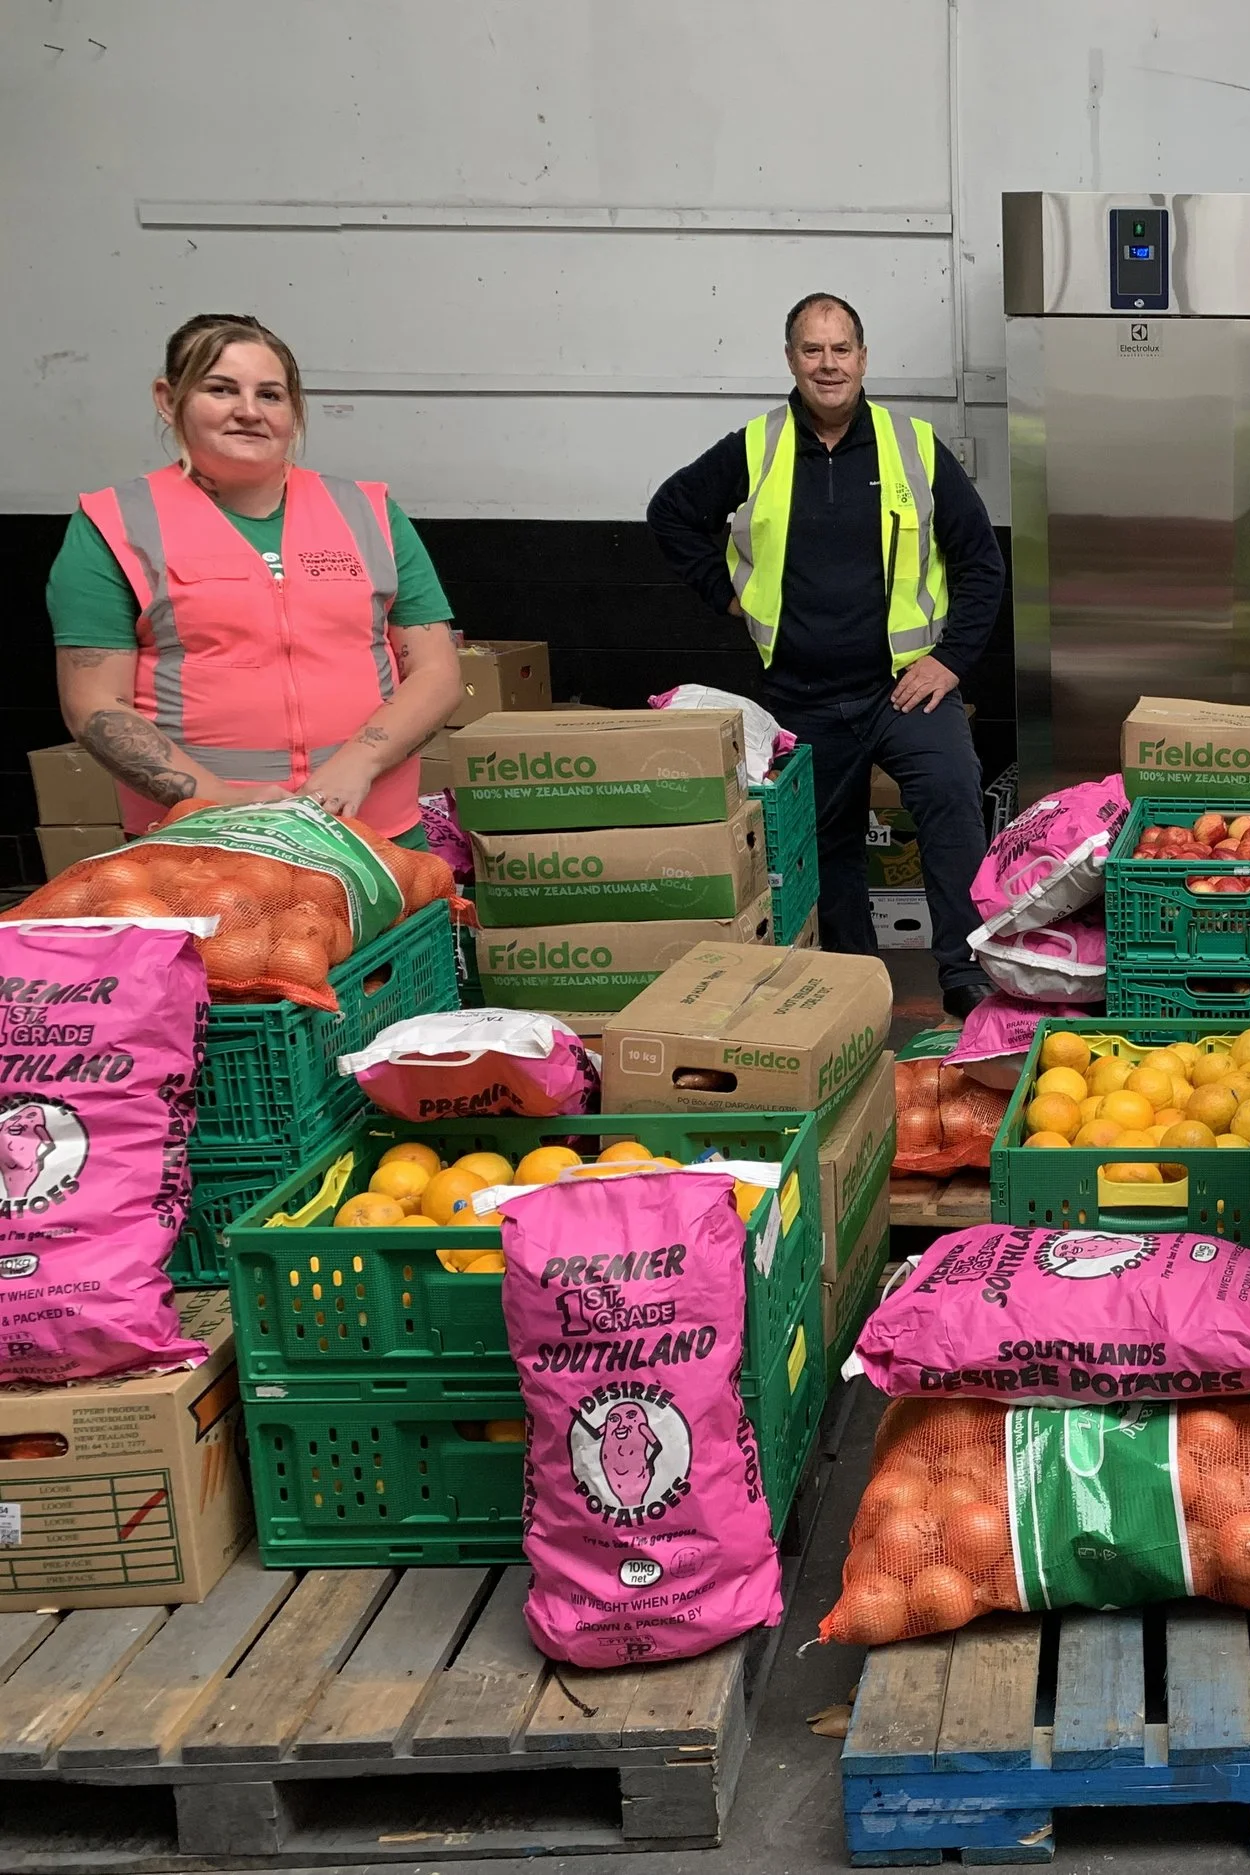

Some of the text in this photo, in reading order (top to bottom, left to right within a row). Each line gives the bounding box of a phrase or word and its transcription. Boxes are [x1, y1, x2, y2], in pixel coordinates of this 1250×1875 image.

[1120, 344, 1160, 353] Electrolux
[467, 751, 597, 782] Fieldco
[1139, 771, 1165, 782] 100%
[1167, 772, 1192, 783] NEW
[1195, 773, 1248, 785] ZEALAND
[471, 783, 651, 800] 100% NEW ZEALAND KUMARA
[228, 841, 273, 854] Packers
[485, 851, 604, 881] Fieldco
[514, 881, 658, 897] NEW ZEALAND KUMARA
[488, 939, 613, 970] Fieldco
[493, 973, 656, 987] 100% NEW ZEALAND KUMAR
[0, 975, 119, 1005] REMIER
[13, 1024, 95, 1046] GRADE
[627, 1050, 657, 1065] 10 kg
[723, 1046, 800, 1070] Fieldco
[817, 1026, 874, 1100] Fieldco
[677, 1096, 690, 1105] PO
[691, 1097, 706, 1106] Box
[708, 1099, 723, 1108] 457
[539, 1243, 688, 1290] PREMIER
[8, 1281, 101, 1301] WHEN PACKED
[2, 1304, 84, 1327] & PACKED BY
[592, 1300, 676, 1335] GRADE
[532, 1324, 718, 1374] SOUTHLAND
[997, 1340, 1167, 1367] SOUTHLAND'S
[1070, 1370, 1243, 1398] POTATOES
[97, 1431, 140, 1441] ZEALAND
[40, 1485, 72, 1494] LOOSE
[41, 1502, 73, 1511] LOOSE
[574, 1476, 692, 1528] POTATOES
[44, 1518, 76, 1527] LOOSE
[46, 1533, 79, 1542] LOOSE
[650, 1528, 697, 1547] gorgeous
[42, 1559, 92, 1569] PRE-PACK
[627, 1561, 655, 1577] 10kg
[630, 1574, 647, 1584] net
[587, 1597, 629, 1613] WEIGHT
[631, 1595, 668, 1611] WHEN
[671, 1581, 716, 1605] PACKED
[575, 1605, 703, 1634] GROWN & PACKED BY
